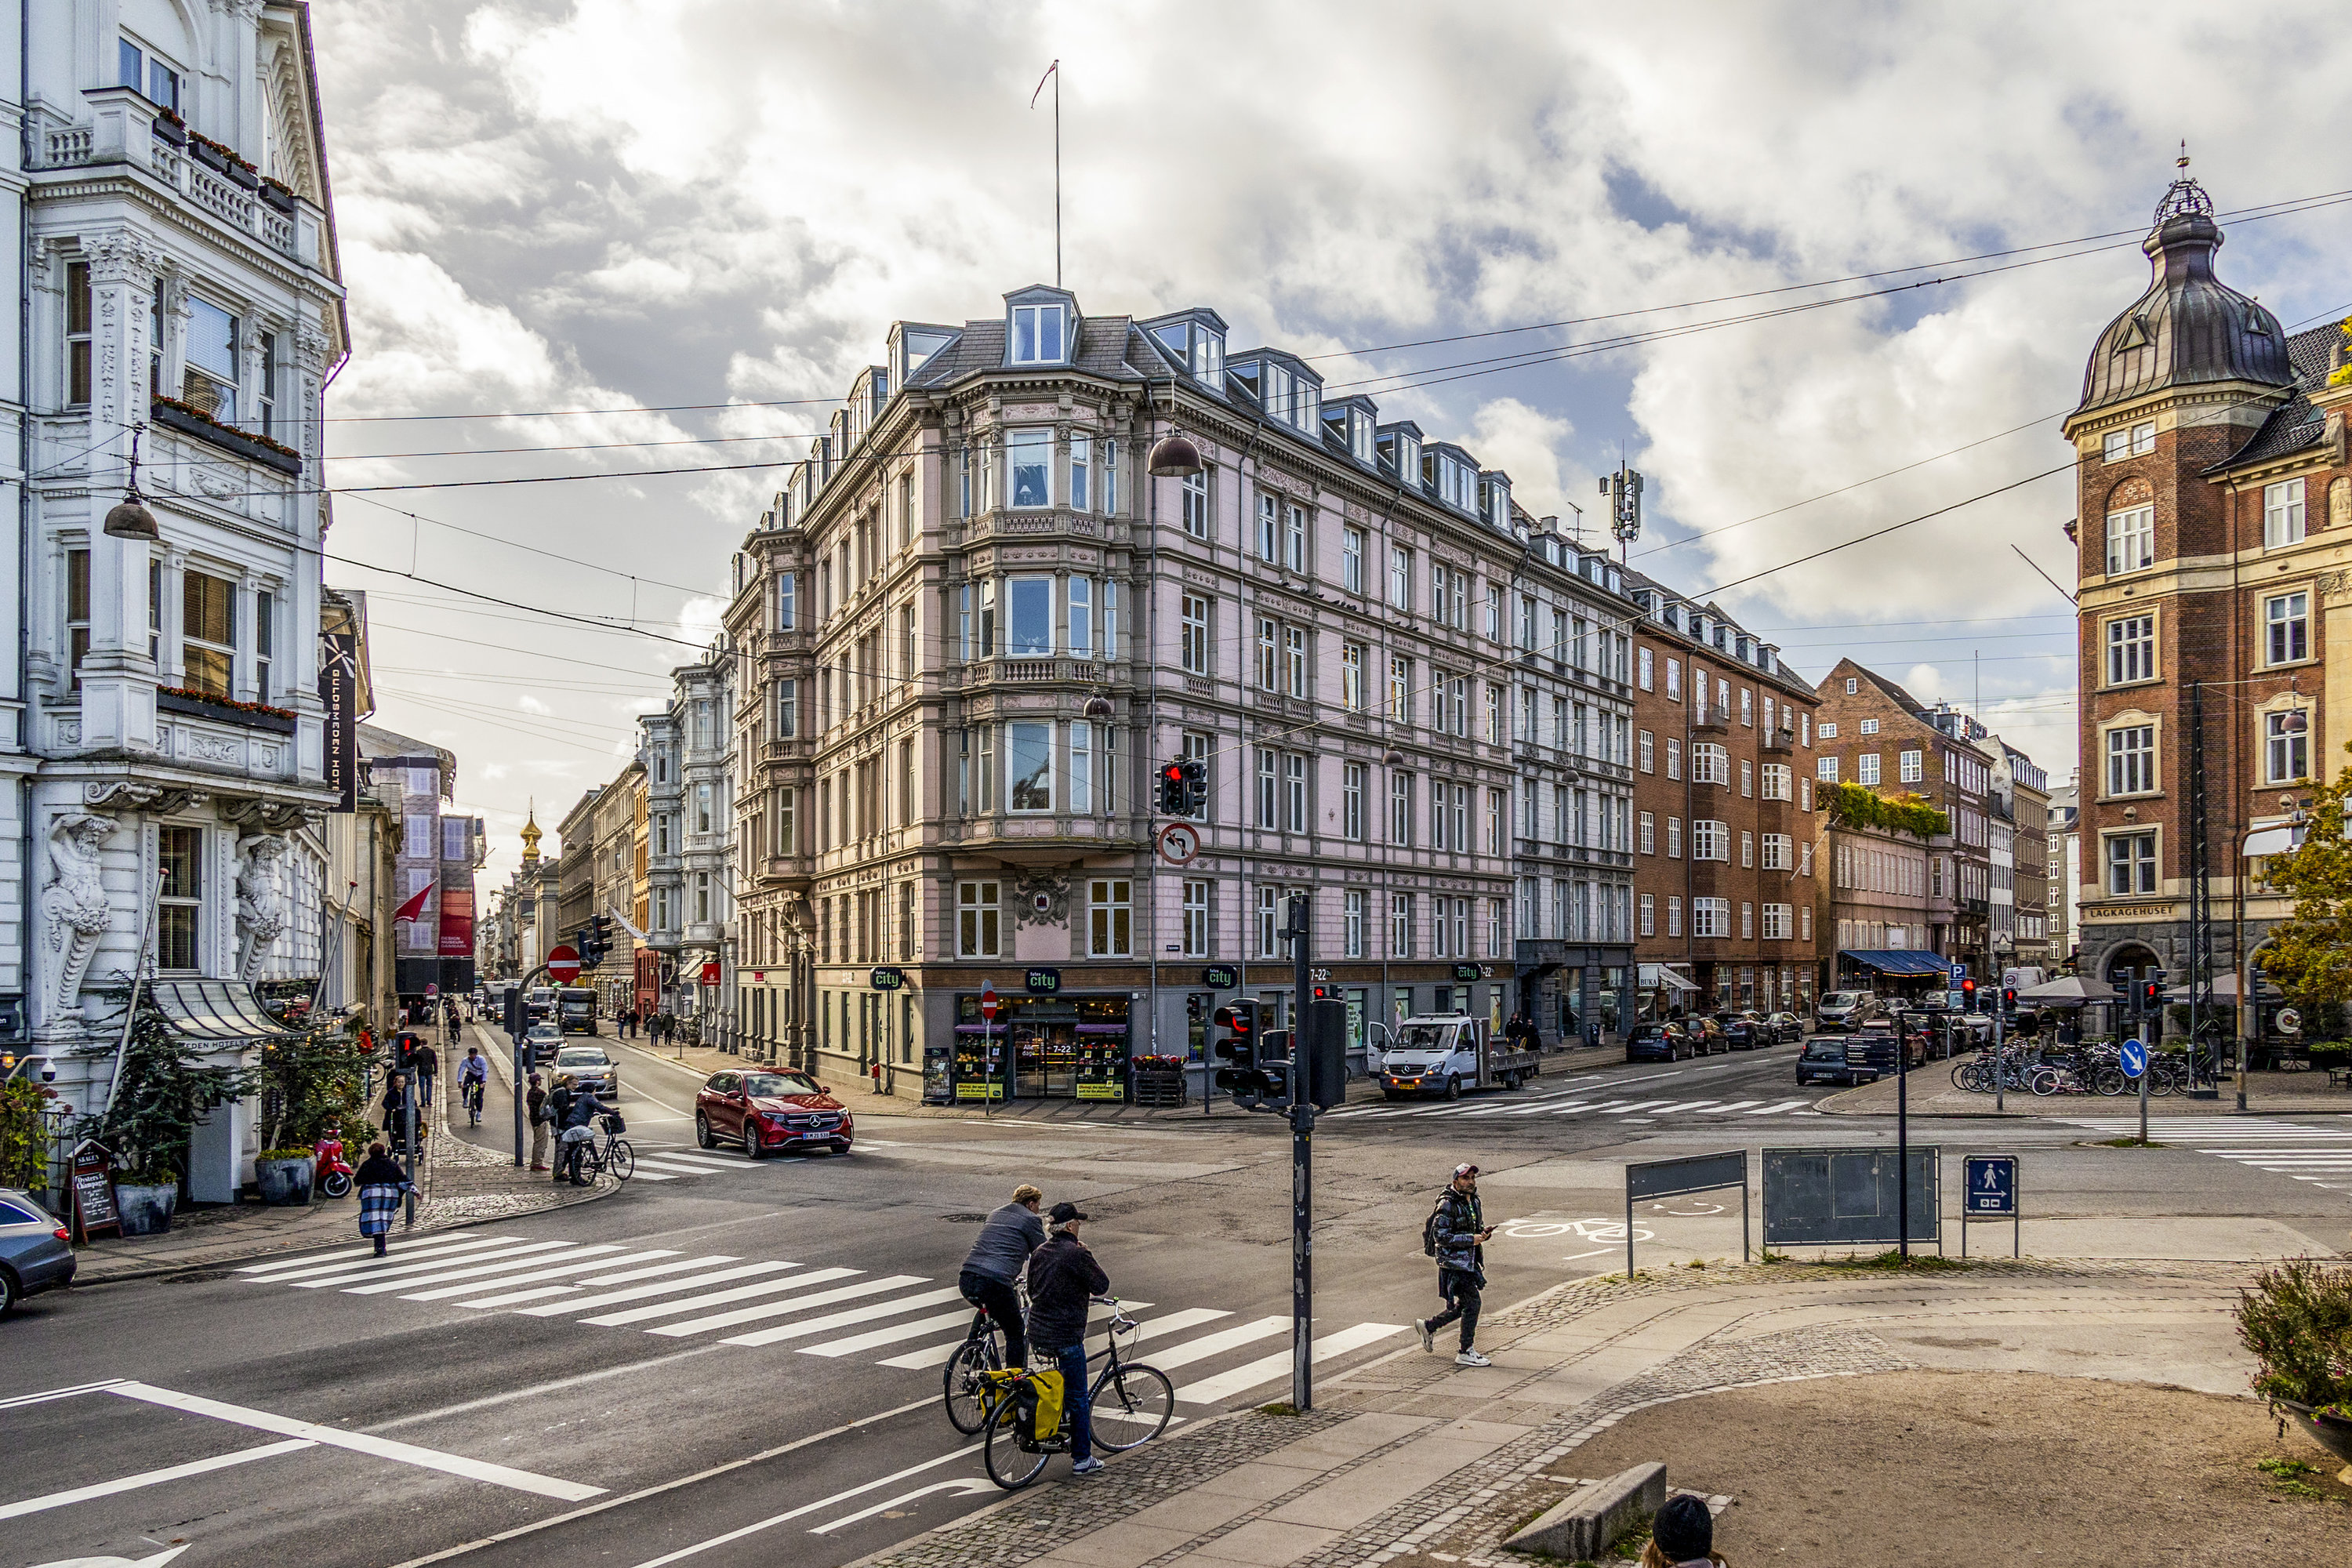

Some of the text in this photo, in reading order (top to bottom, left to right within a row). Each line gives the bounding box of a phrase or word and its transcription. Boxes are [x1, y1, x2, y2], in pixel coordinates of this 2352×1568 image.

[2090, 906, 2173, 917] LAGKAGEHUSET
[1310, 968, 1327, 981] 7-22
[1458, 967, 1477, 979] city
[1953, 966, 1962, 978] P
[875, 972, 899, 987] city
[1029, 973, 1055, 989] city
[1209, 971, 1231, 986] city
[212, 1040, 245, 1048] HOTELS
[78, 1174, 99, 1185] Oysters
